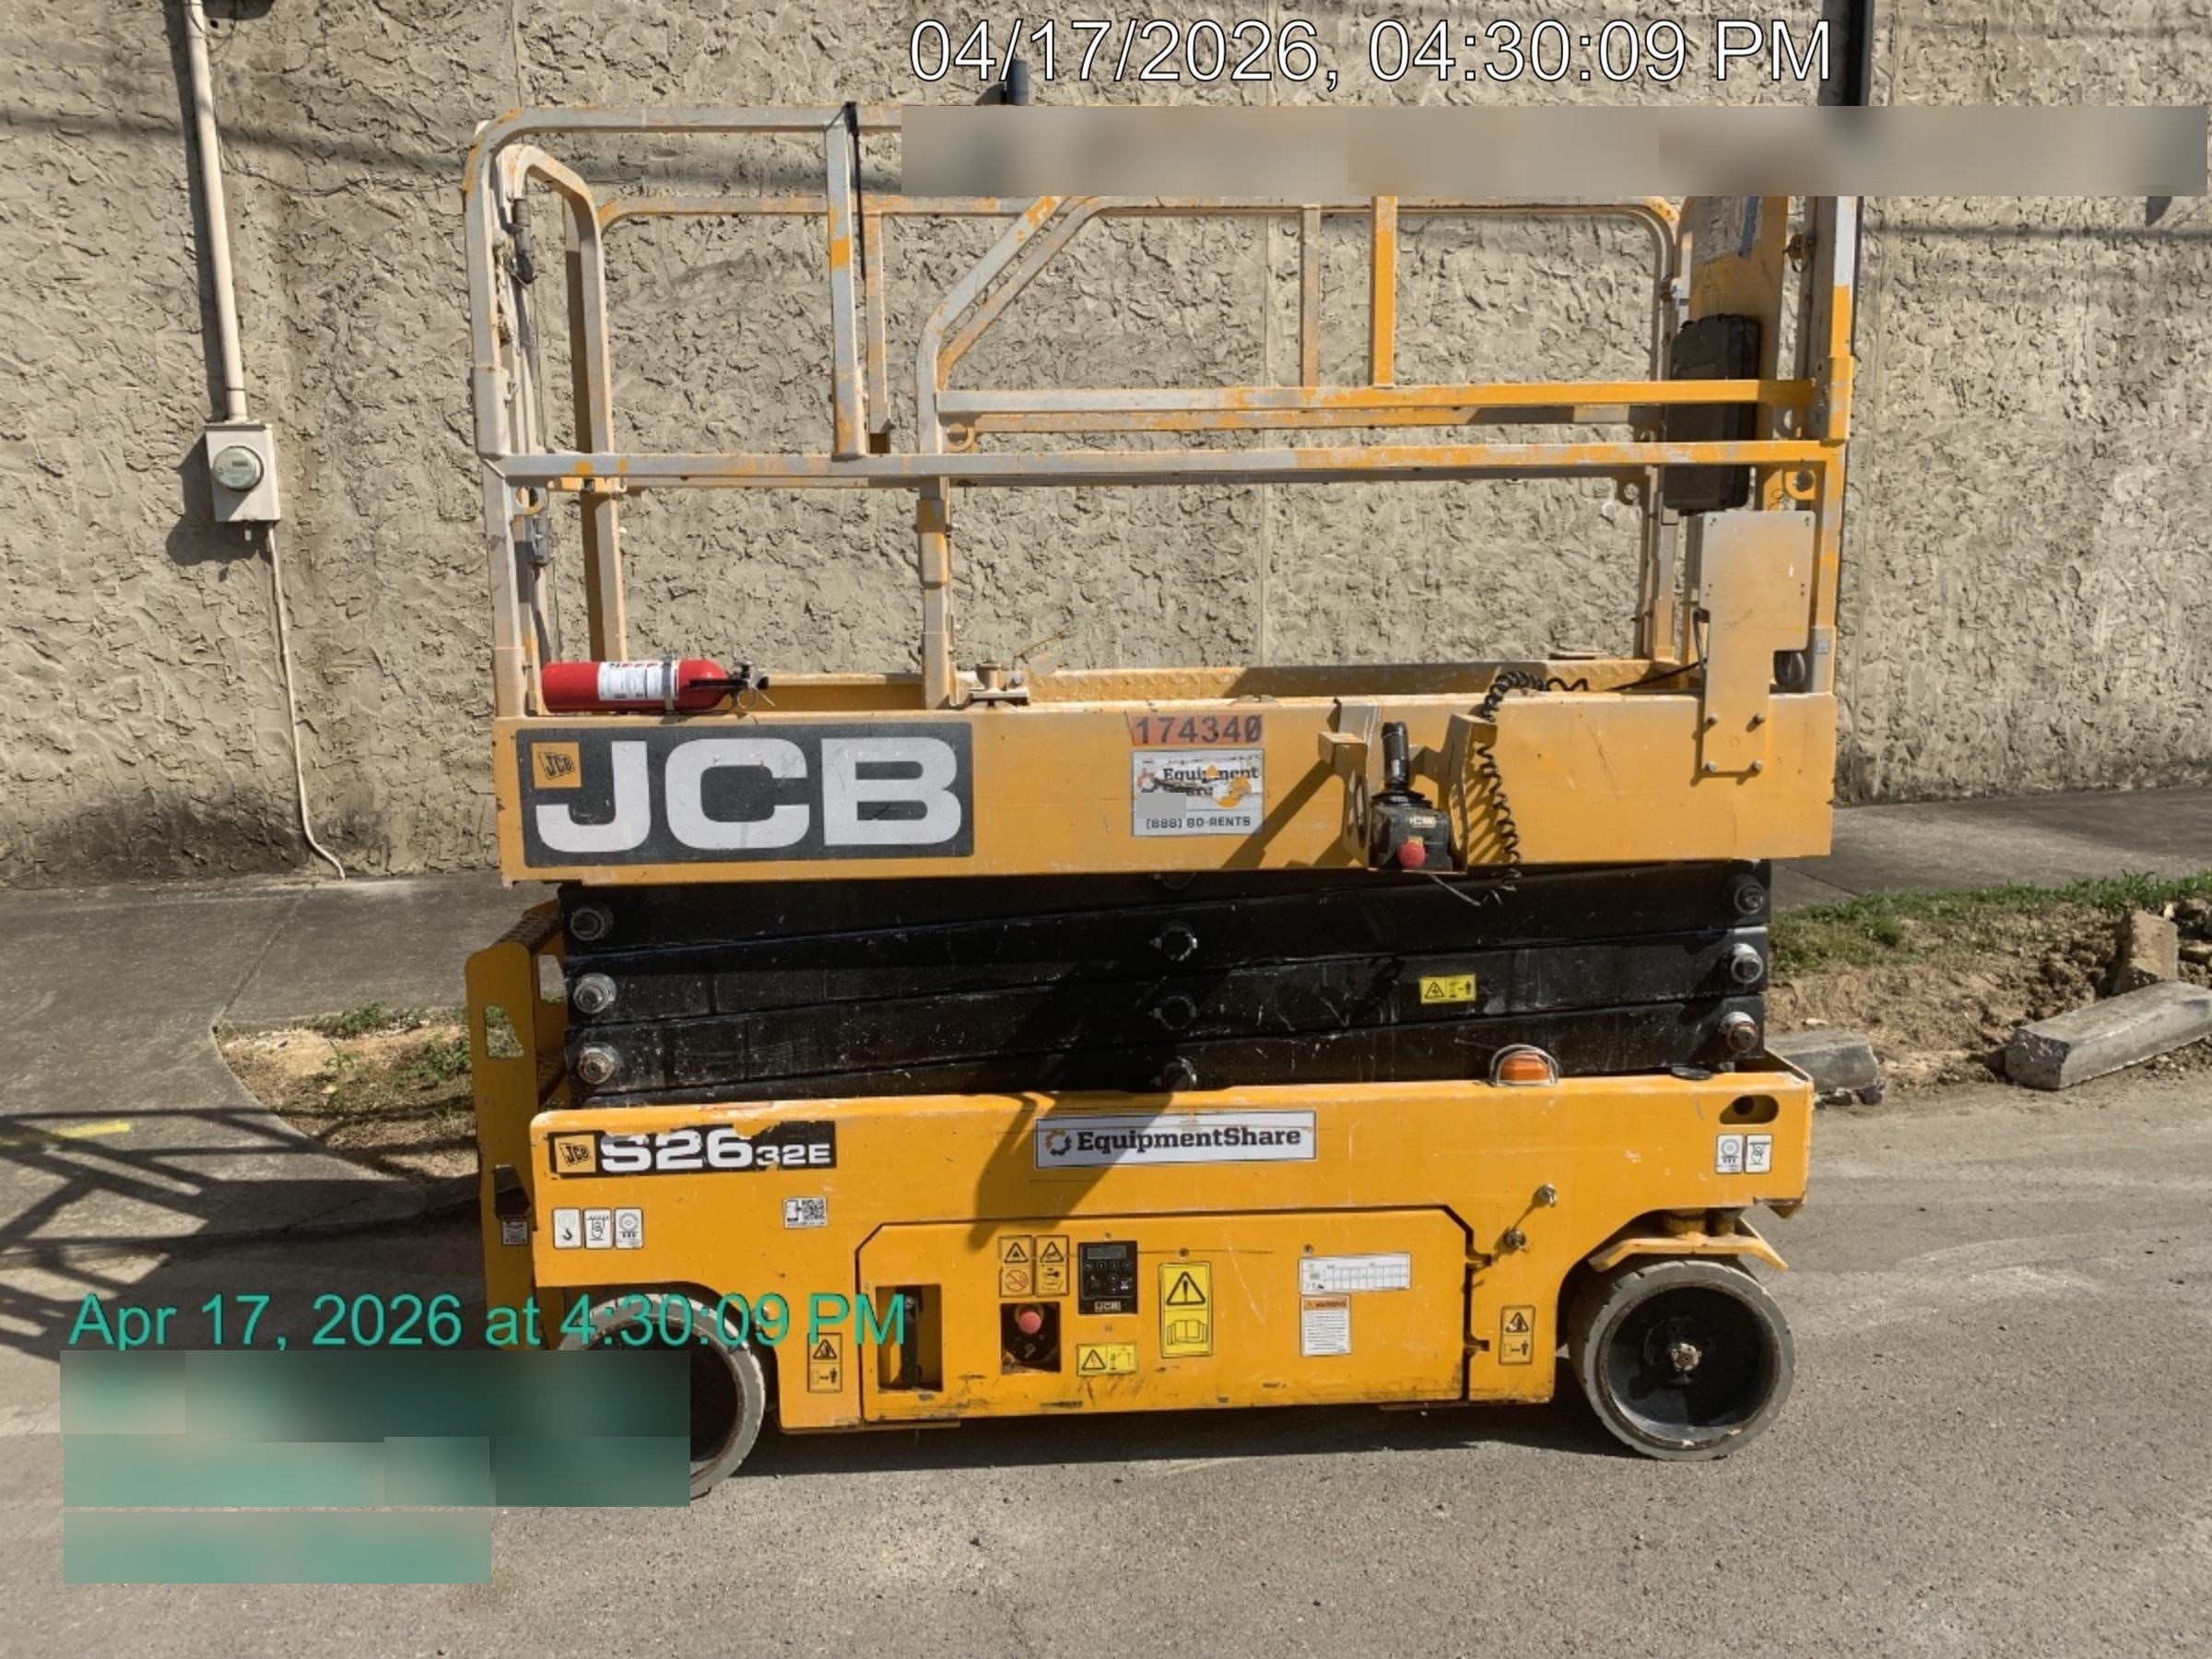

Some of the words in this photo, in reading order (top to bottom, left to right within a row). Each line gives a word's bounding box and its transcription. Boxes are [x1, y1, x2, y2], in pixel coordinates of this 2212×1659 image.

[1136, 715, 1263, 744] 174340
[538, 752, 575, 780] JCB
[535, 738, 961, 853] JCB
[1077, 1126, 1301, 1154] EquipmentShare
